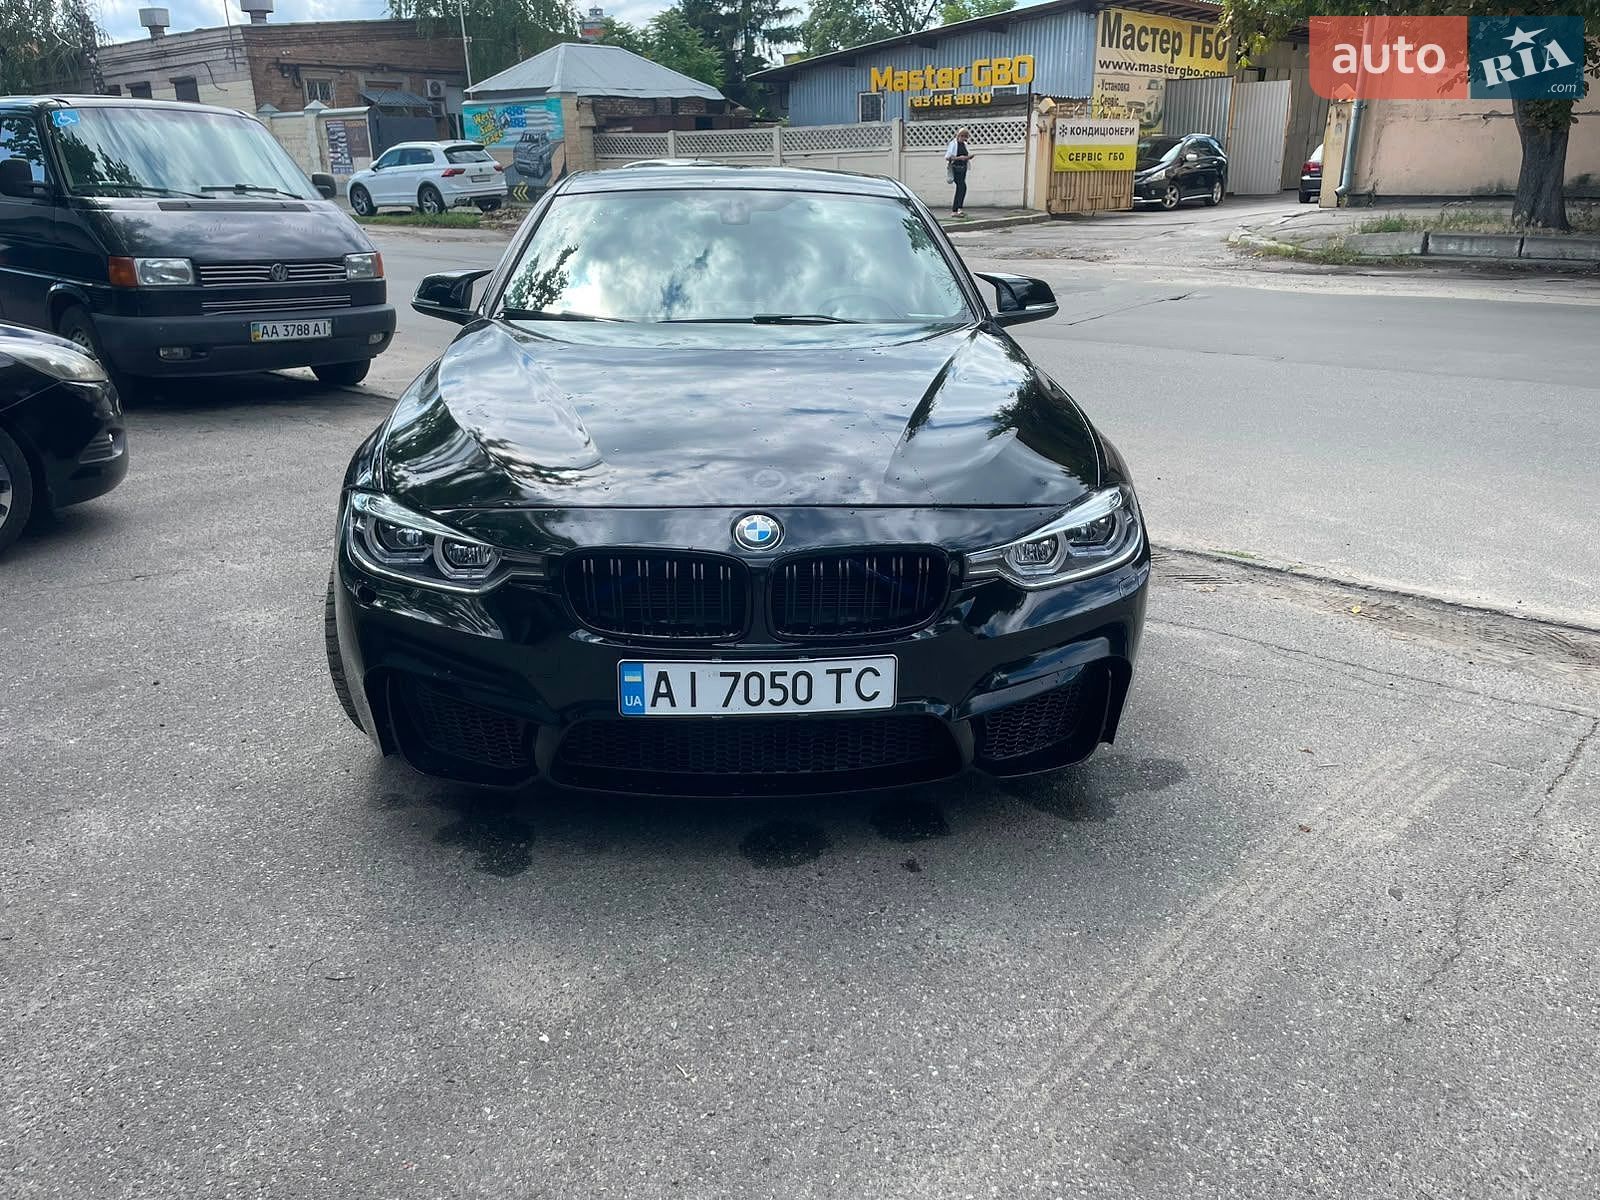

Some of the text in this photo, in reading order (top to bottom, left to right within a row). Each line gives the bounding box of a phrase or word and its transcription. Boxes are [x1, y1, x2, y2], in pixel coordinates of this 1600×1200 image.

[1100, 11, 1227, 64] Мастер ГБО
[870, 54, 1035, 94] Master GBO
[1098, 59, 1226, 79] www.mastergbo.com
[908, 92, 992, 108] газ на авто
[1070, 126, 1135, 138] КОНДИЦІОНЕРИ
[1068, 152, 1125, 161] СЕРВІС ГБО
[261, 322, 327, 338] AA 3788 AI
[650, 667, 881, 708] AI 7050 TC
[625, 696, 642, 706] UA
